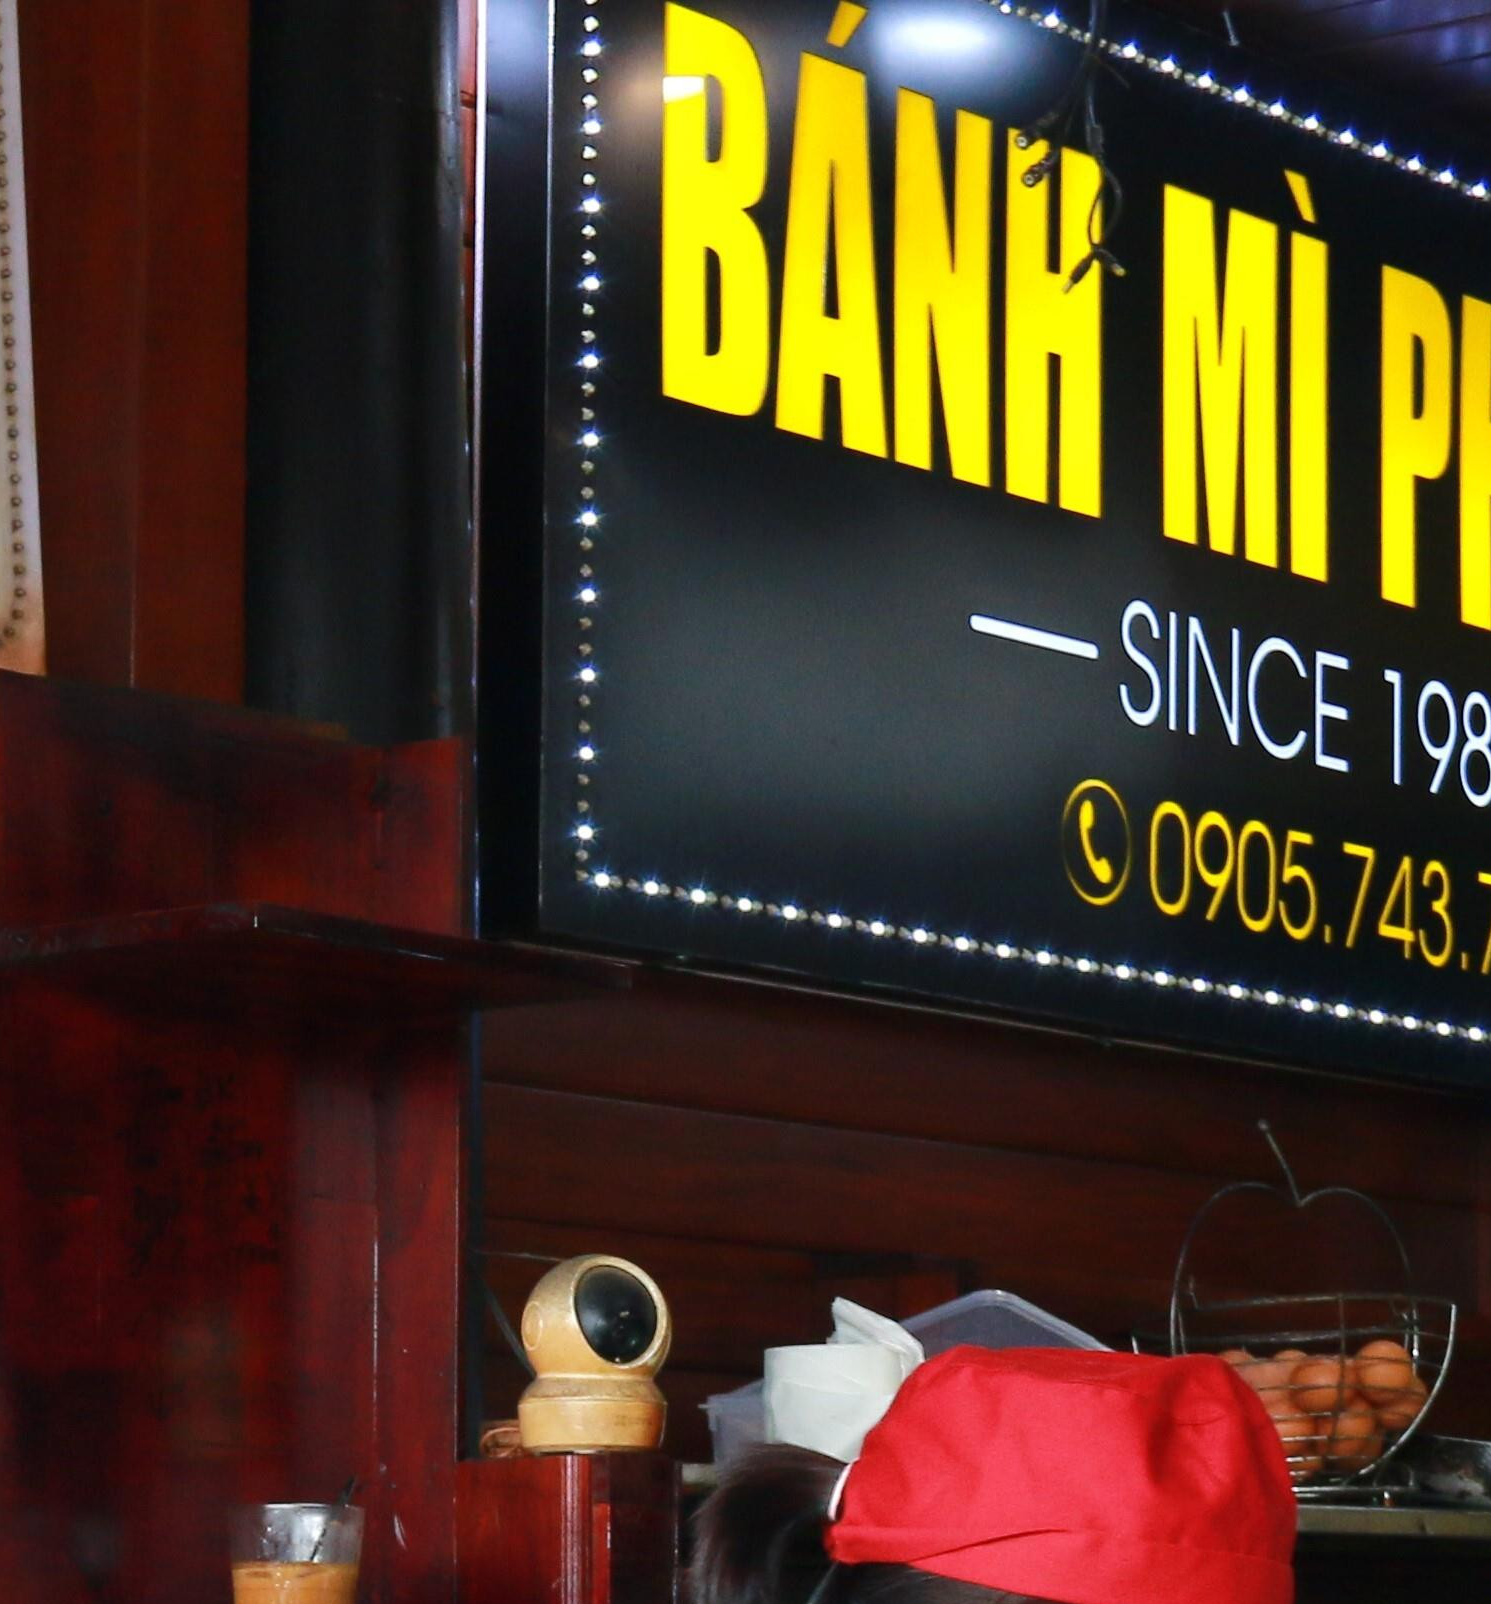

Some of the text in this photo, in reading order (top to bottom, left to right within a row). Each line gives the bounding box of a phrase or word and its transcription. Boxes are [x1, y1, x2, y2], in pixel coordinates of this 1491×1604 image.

[662, 1, 1102, 518] BÁNH
[1163, 169, 1329, 583] MÌ
[1119, 599, 1350, 773] SINCE
